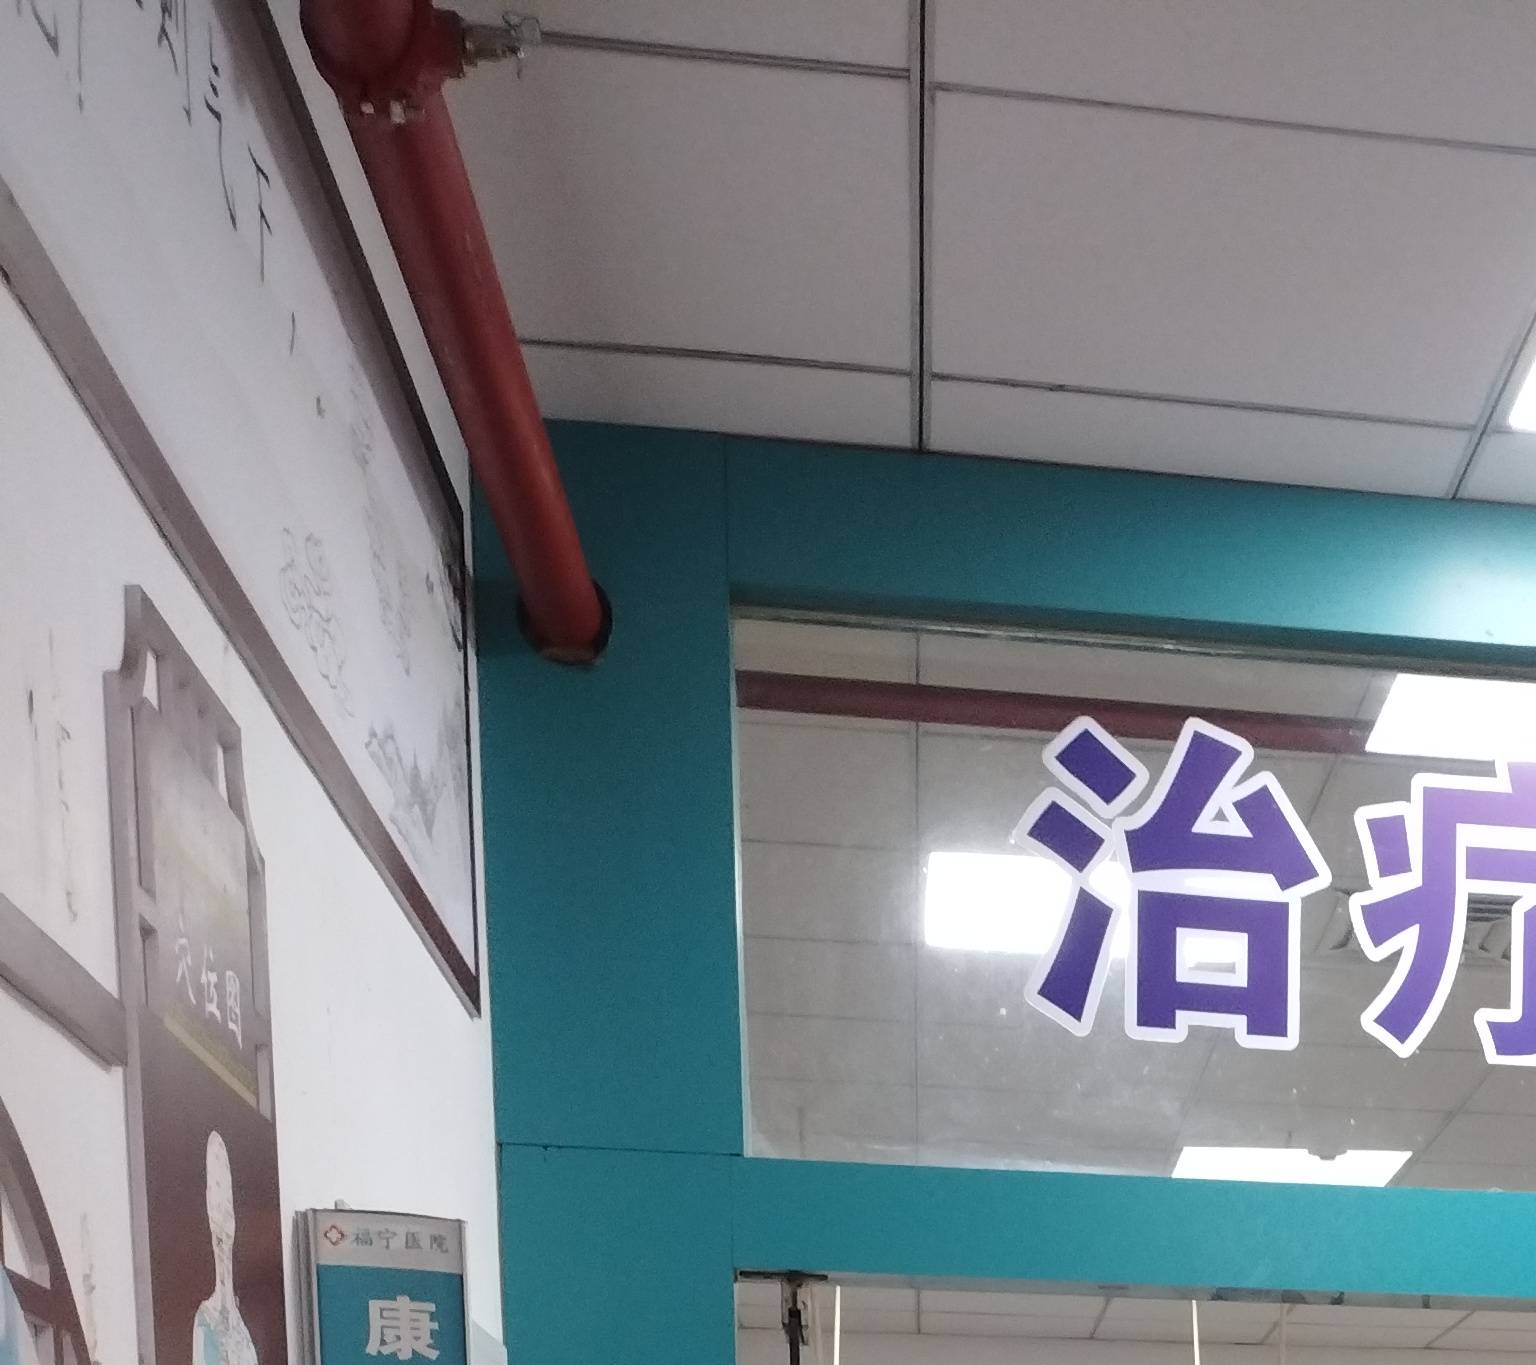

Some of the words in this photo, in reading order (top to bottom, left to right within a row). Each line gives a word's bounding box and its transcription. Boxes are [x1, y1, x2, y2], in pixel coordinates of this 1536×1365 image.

[174, 912, 244, 1051] 穴位图
[351, 1227, 450, 1254] 福宁医院
